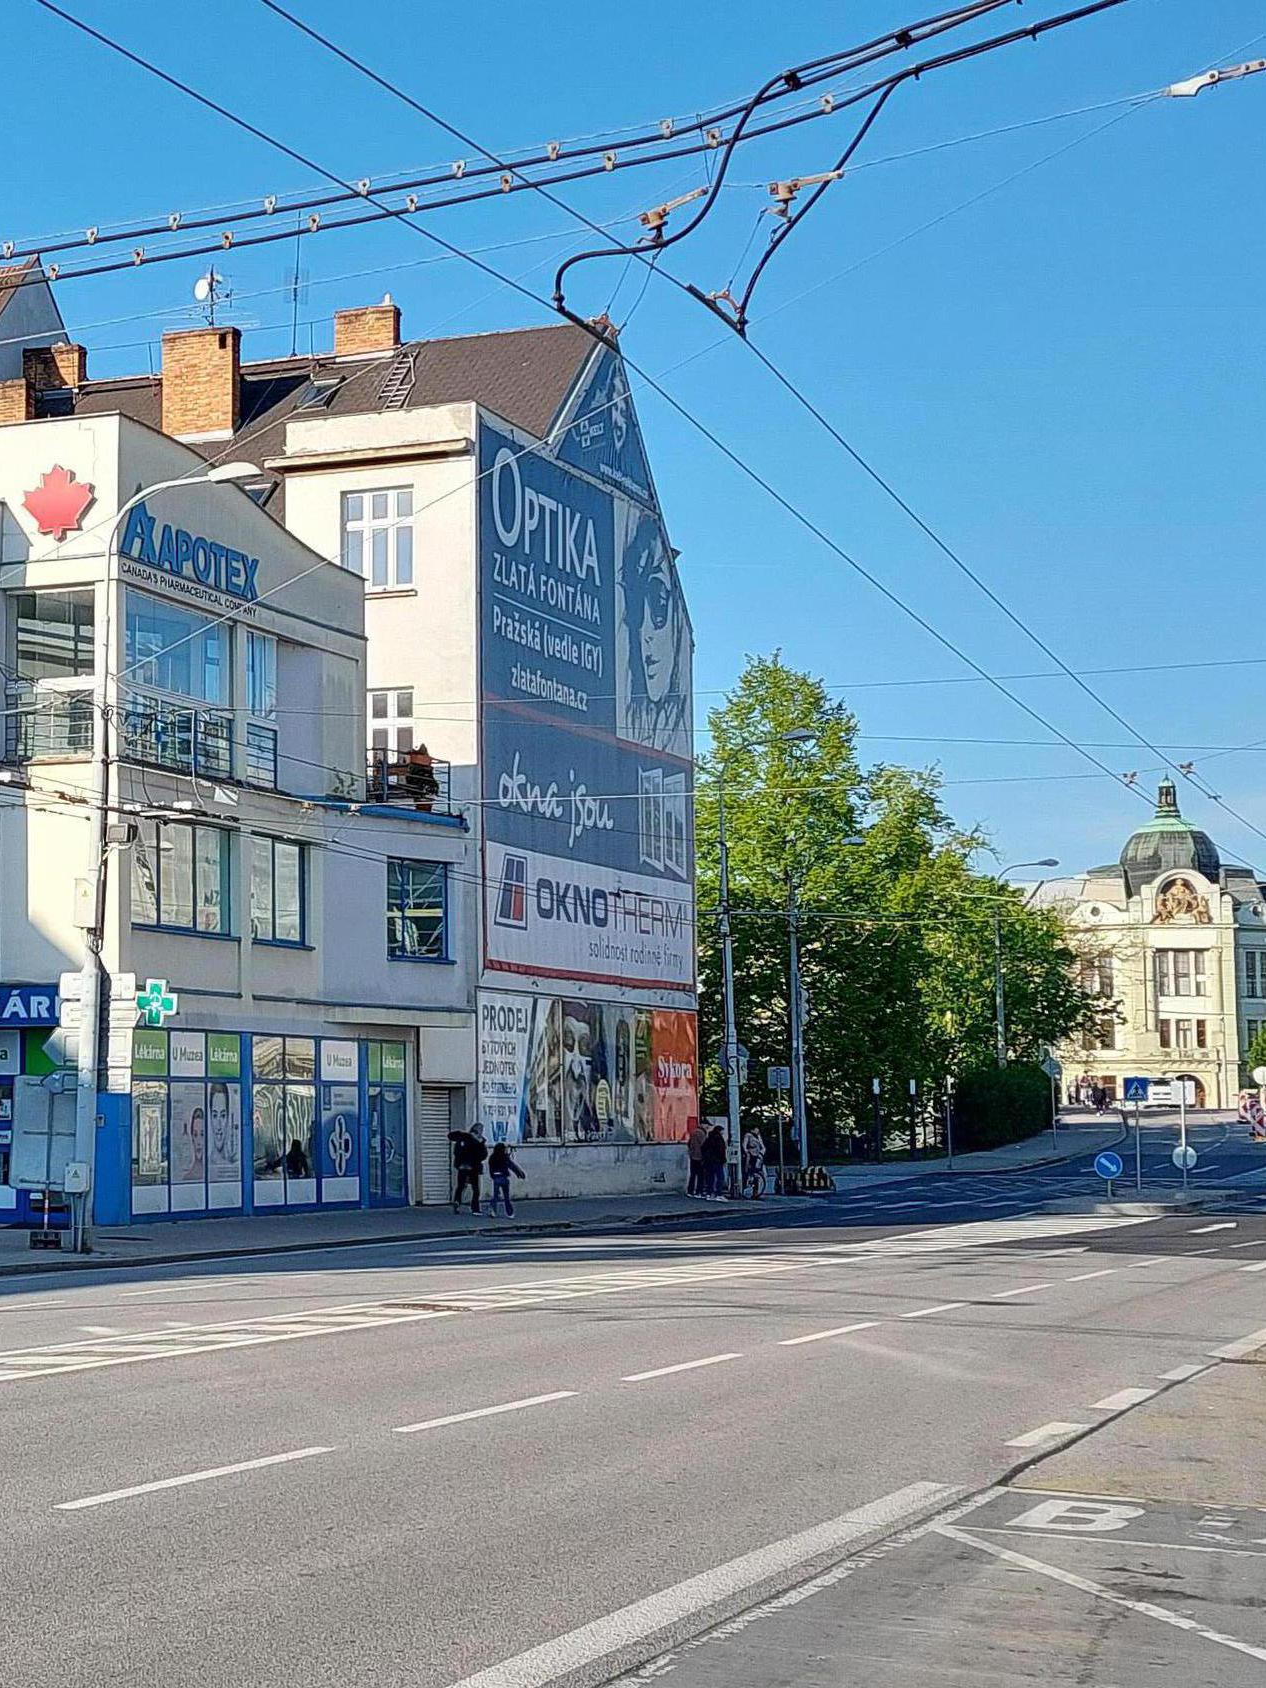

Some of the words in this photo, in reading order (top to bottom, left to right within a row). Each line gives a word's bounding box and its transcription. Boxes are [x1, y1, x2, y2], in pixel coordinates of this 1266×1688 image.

[492, 447, 602, 587] OPTIKA
[121, 562, 158, 585] CANADA'S
[159, 575, 225, 606] PHARMACEUTICAL
[155, 524, 259, 600] APOTEX
[493, 552, 535, 599] ZLATÁ
[540, 574, 601, 625] FONTÁNA
[493, 605, 541, 652] Pražská
[544, 624, 578, 666] (vedle
[581, 640, 603, 678] IGY)
[511, 662, 588, 712] zlatafontana.cz
[498, 751, 563, 818] okna
[568, 769, 614, 848] jsou
[536, 877, 684, 940] OKNOTHERM
[482, 1004, 528, 1034] PRODEJ
[134, 1043, 166, 1060] Lékárna
[210, 1046, 239, 1063] Lékárna
